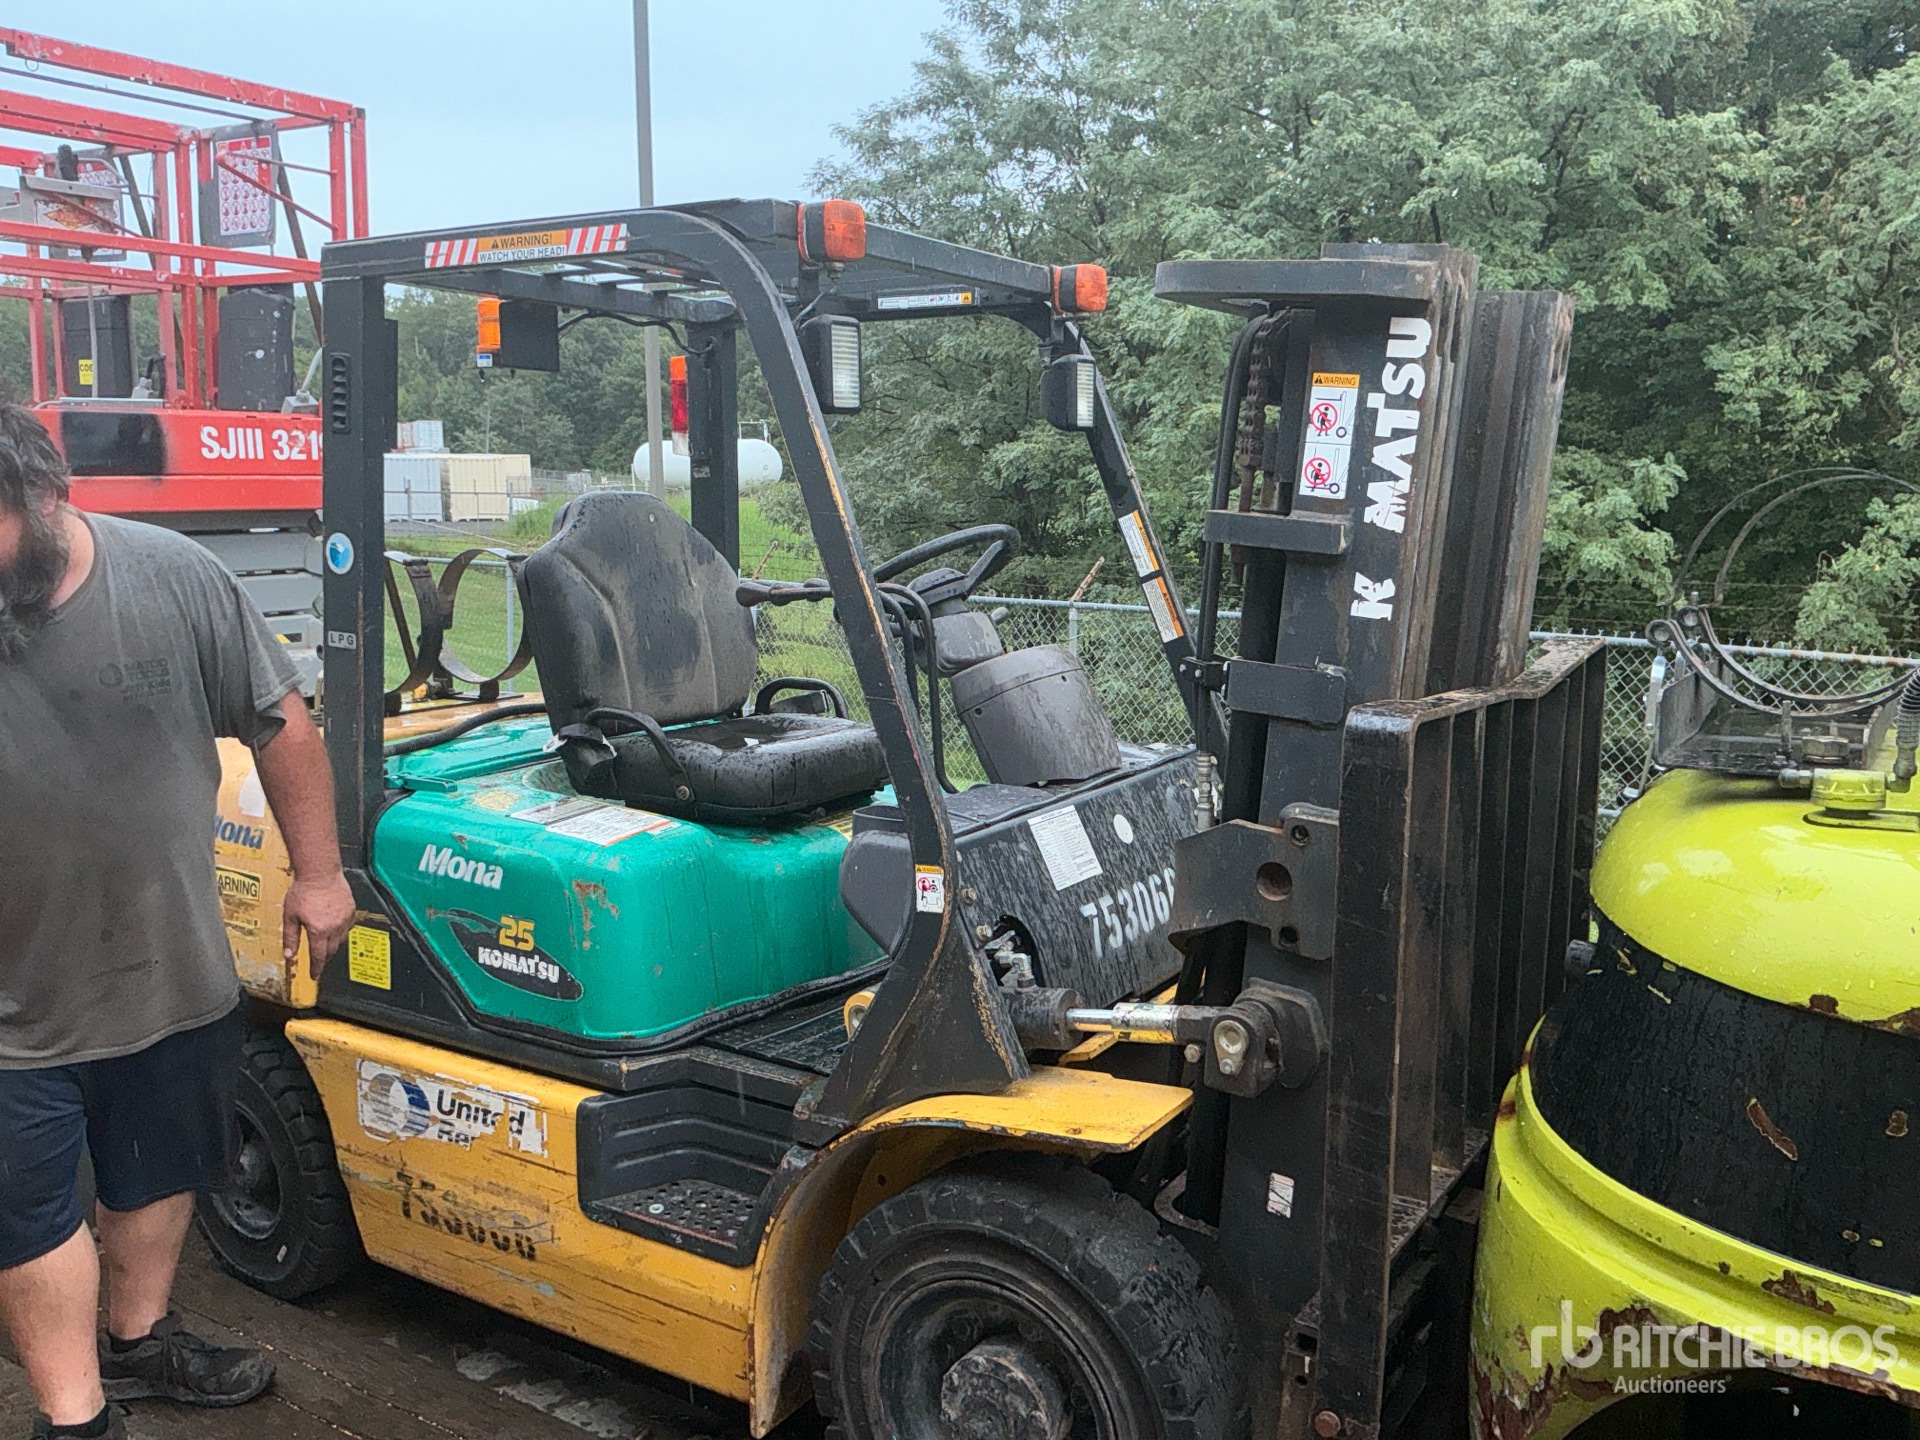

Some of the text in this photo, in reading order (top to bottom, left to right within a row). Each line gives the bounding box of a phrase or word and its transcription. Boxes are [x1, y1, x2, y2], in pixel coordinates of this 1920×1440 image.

[479, 246, 565, 263] WATCH YOUR HEAD!
[501, 233, 553, 248] WARNING!
[1323, 375, 1356, 387] WARNING
[200, 426, 265, 460] SJIII
[1350, 316, 1432, 622] KMATSU
[330, 632, 354, 646] LPG
[418, 843, 504, 890] Mona
[217, 874, 258, 898] ARNING
[499, 915, 535, 951] 25
[478, 946, 560, 983] KOMATSU
